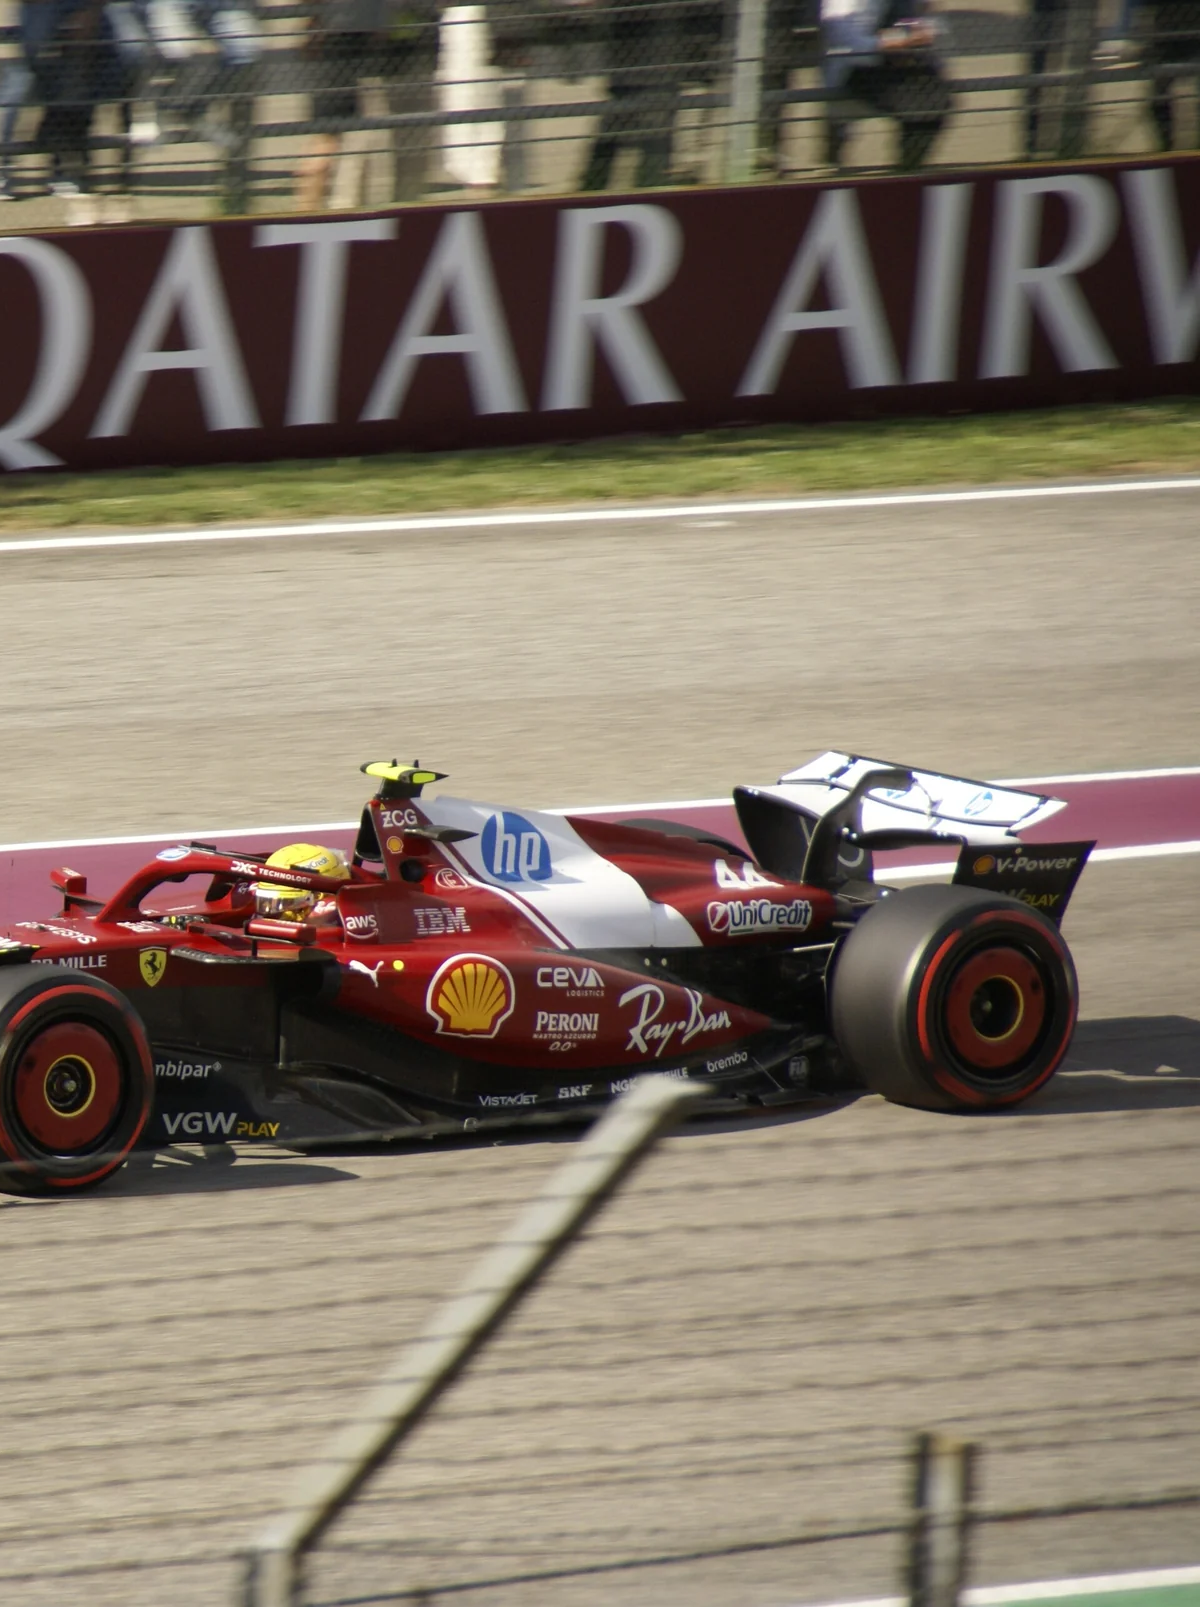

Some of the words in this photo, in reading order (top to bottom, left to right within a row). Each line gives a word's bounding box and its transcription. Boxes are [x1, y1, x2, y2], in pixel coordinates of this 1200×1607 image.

[381, 809, 418, 828] ZCG
[487, 811, 548, 882] hp
[231, 861, 258, 876] DXC
[259, 868, 312, 884] TECHNOLOGY
[715, 859, 785, 888] 44
[997, 857, 1077, 873] V-Power
[346, 915, 377, 930] aws
[413, 907, 471, 935] IBM
[729, 900, 811, 929] UniCredit
[566, 989, 605, 997] LOGISTICS
[535, 1011, 600, 1032] PERONI
[707, 1050, 748, 1074] brembo
[558, 1084, 592, 1099] SKF
[162, 1112, 237, 1135] VGW
[237, 1122, 281, 1137] PLAY
